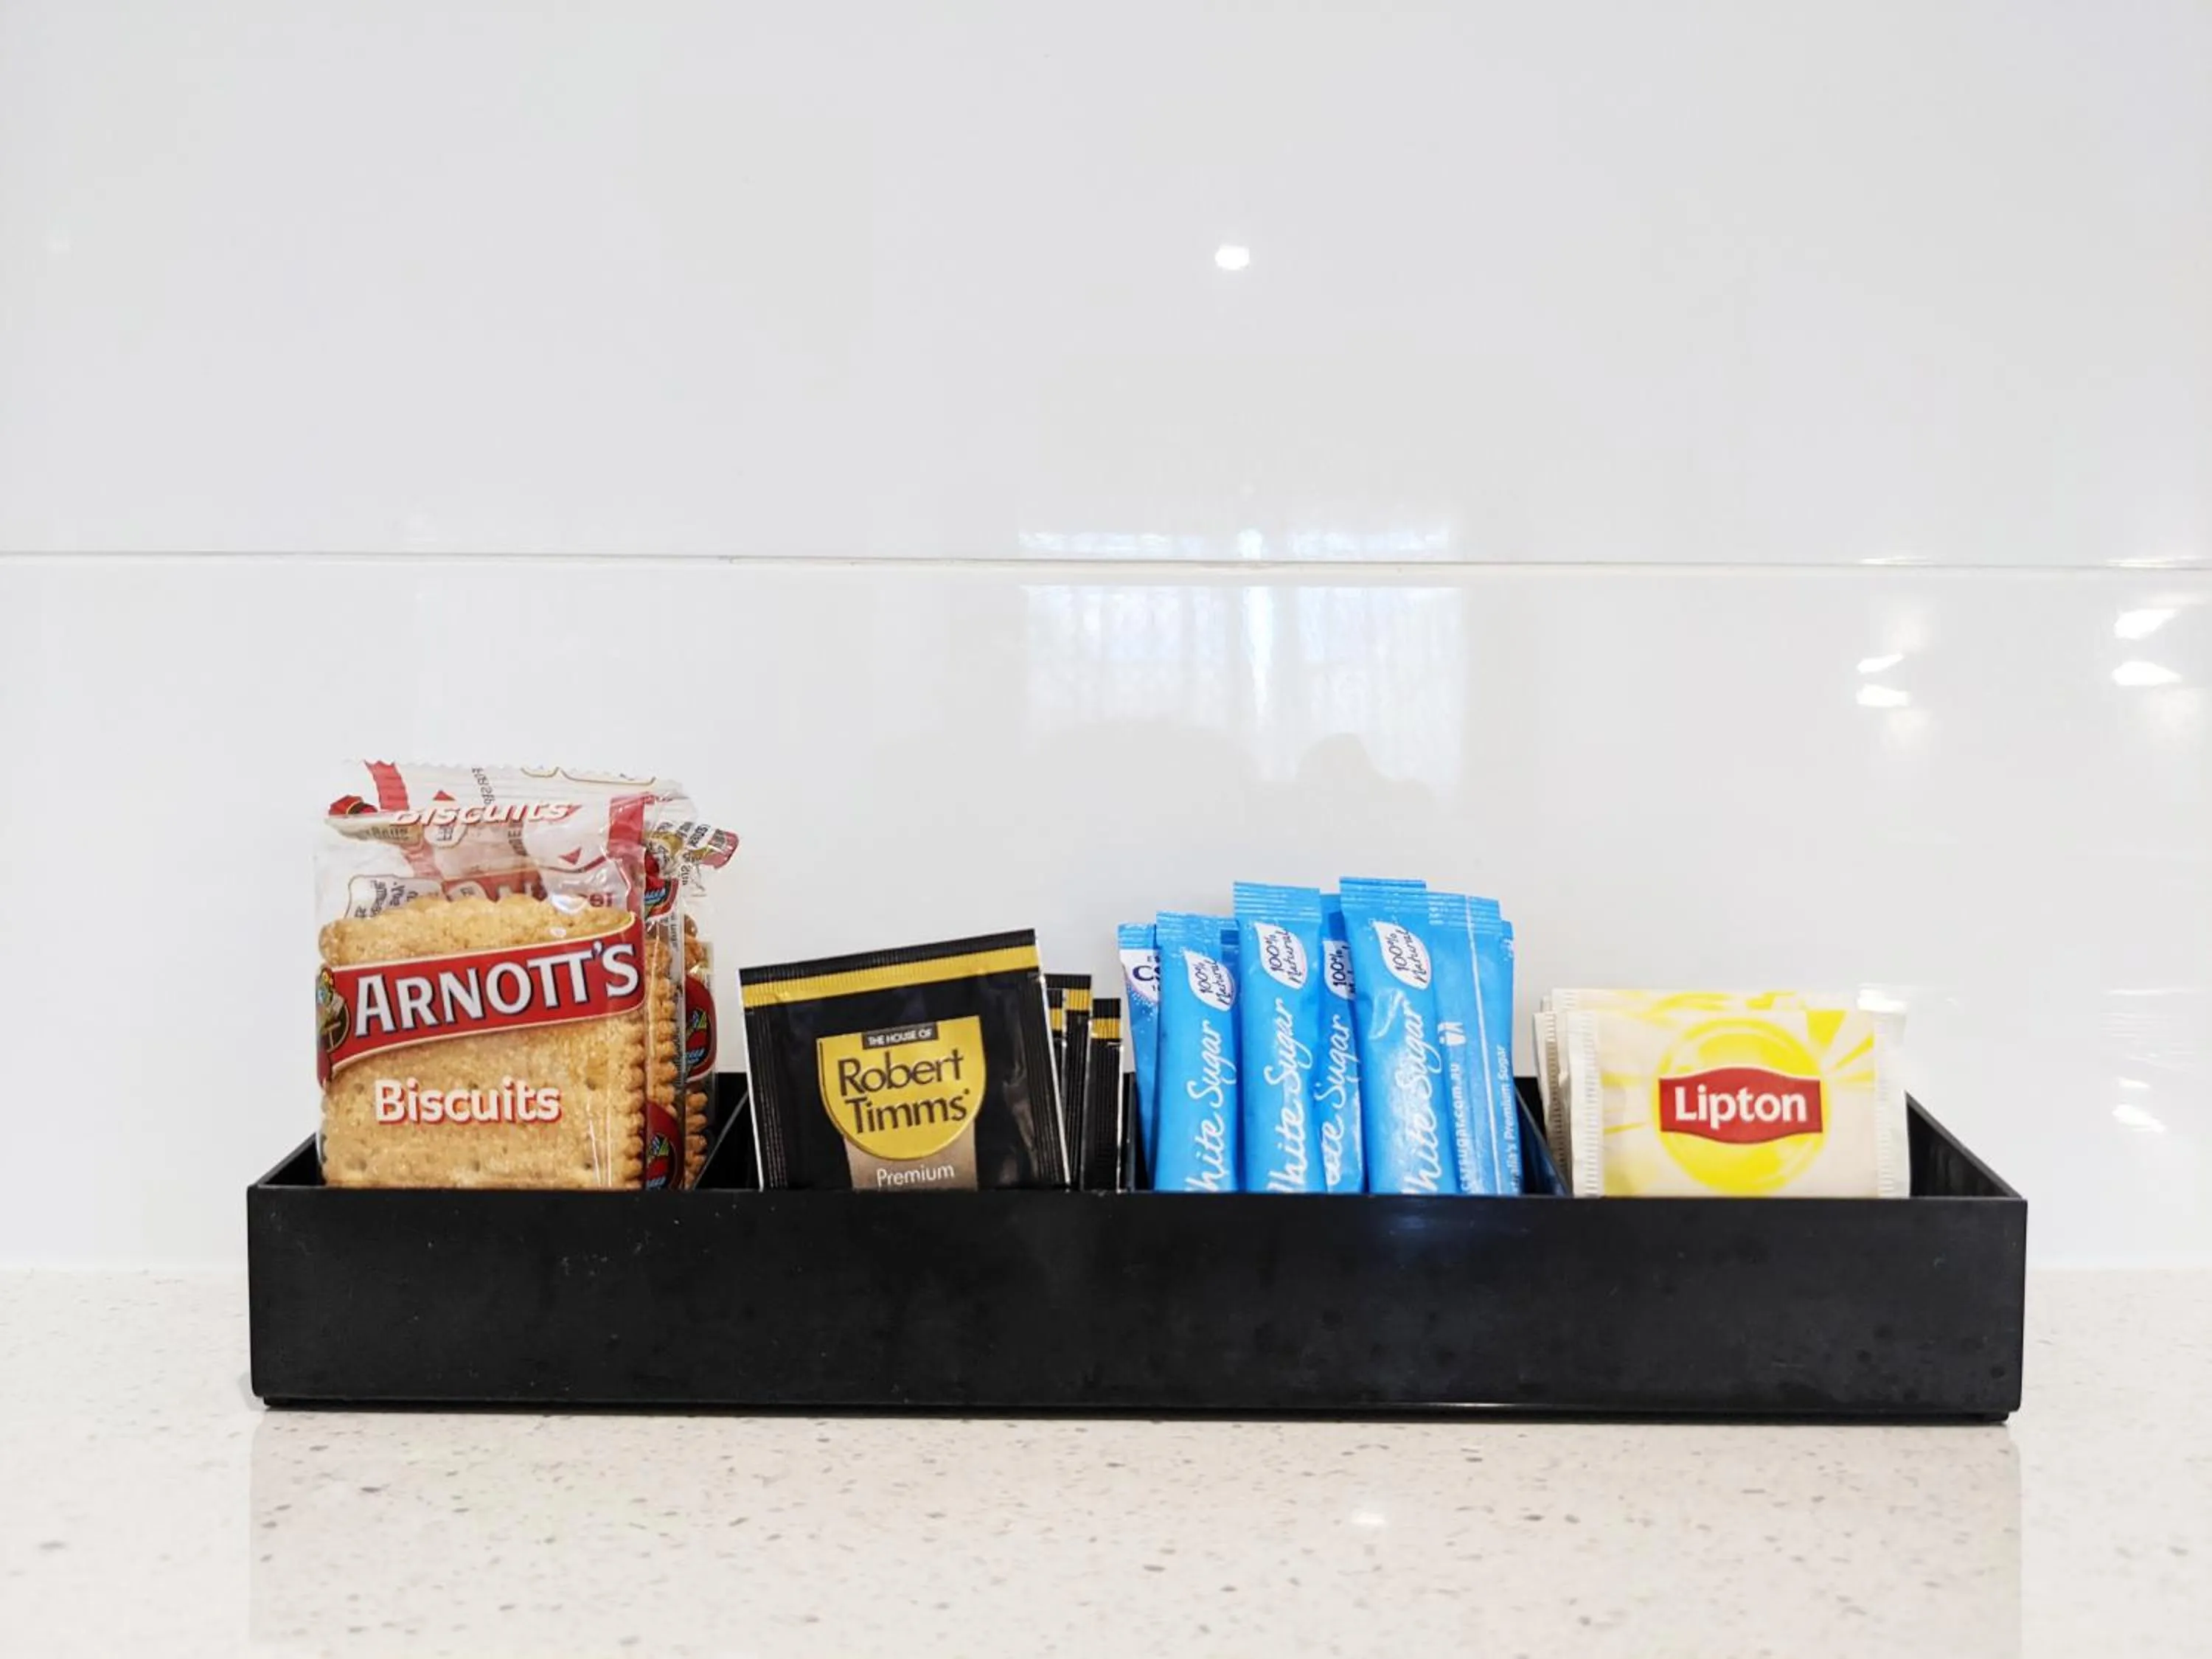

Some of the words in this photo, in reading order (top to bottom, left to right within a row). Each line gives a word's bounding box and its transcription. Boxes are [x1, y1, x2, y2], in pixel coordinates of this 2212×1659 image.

[1265, 934, 1283, 973] 100%
[1276, 928, 1302, 984] Natural
[1329, 949, 1346, 986] 100%
[1385, 933, 1407, 971] 100%
[1396, 928, 1427, 984] Natural
[355, 942, 639, 1037] ARNOTT'S
[1194, 961, 1212, 994] 100%
[868, 1034, 885, 1046] THE
[886, 1030, 917, 1044] HOUSE
[918, 1028, 932, 1038] OF
[1264, 998, 1312, 1094] Sugar
[1394, 998, 1441, 1099] Sugar
[838, 1048, 964, 1096] Robert
[1186, 1019, 1237, 1107] Sugar
[1496, 1044, 1509, 1081] Sugar
[376, 1076, 563, 1124] Biscuits
[844, 1094, 967, 1134] Timms
[1503, 1082, 1515, 1141] Premium
[1674, 1083, 1807, 1130] Lipton
[1185, 1111, 1230, 1192] hite
[1402, 1105, 1441, 1193] hite
[876, 1164, 955, 1189] Premium
